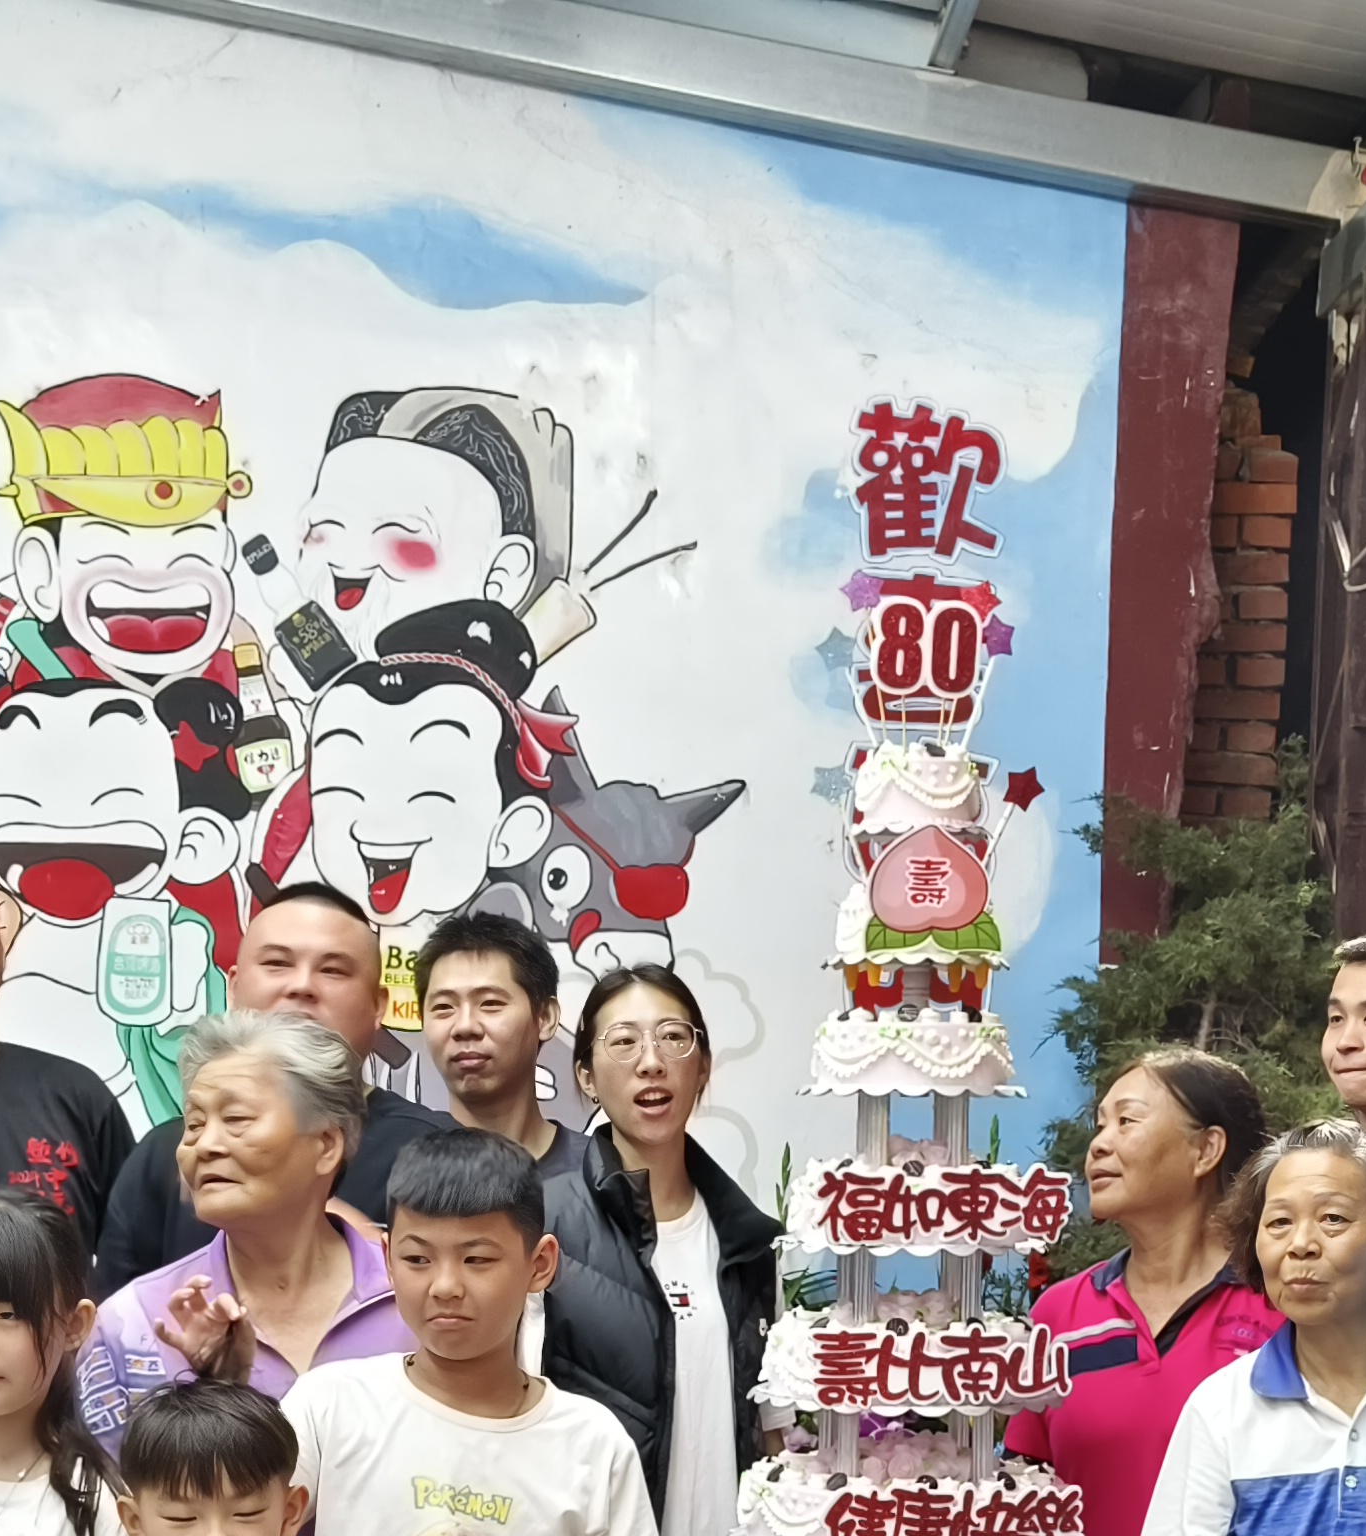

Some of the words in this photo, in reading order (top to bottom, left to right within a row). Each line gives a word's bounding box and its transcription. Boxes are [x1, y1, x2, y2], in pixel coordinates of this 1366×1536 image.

[874, 600, 981, 696] 80
[908, 859, 950, 905] 壽
[816, 1167, 1071, 1243] 福如東海
[812, 1326, 1071, 1407] 壽比南山
